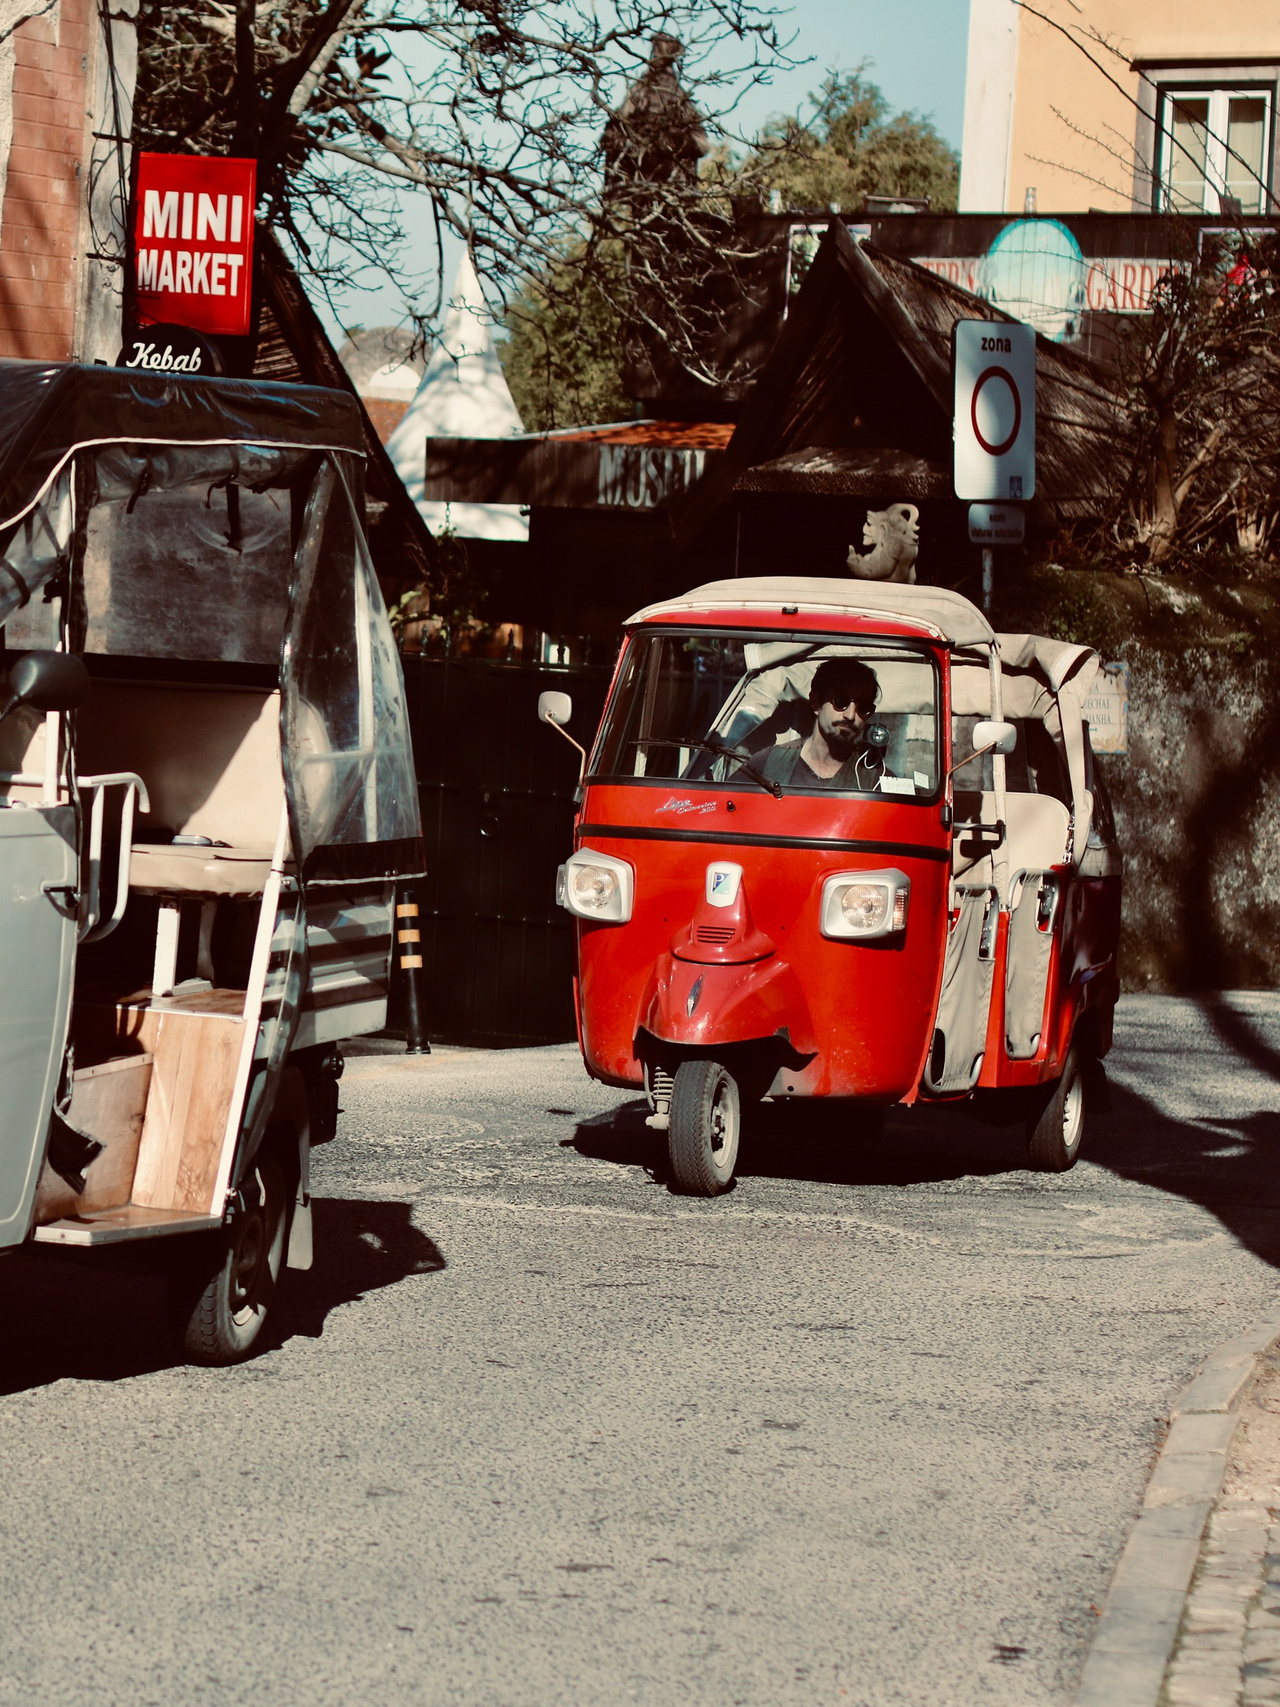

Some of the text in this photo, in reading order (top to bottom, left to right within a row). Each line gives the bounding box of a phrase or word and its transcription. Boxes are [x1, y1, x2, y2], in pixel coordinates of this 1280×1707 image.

[142, 189, 243, 243] MINI
[137, 248, 244, 297] MARKET
[1086, 263, 1182, 311] GARD
[125, 341, 202, 372] Kebab
[981, 336, 1012, 353] zona
